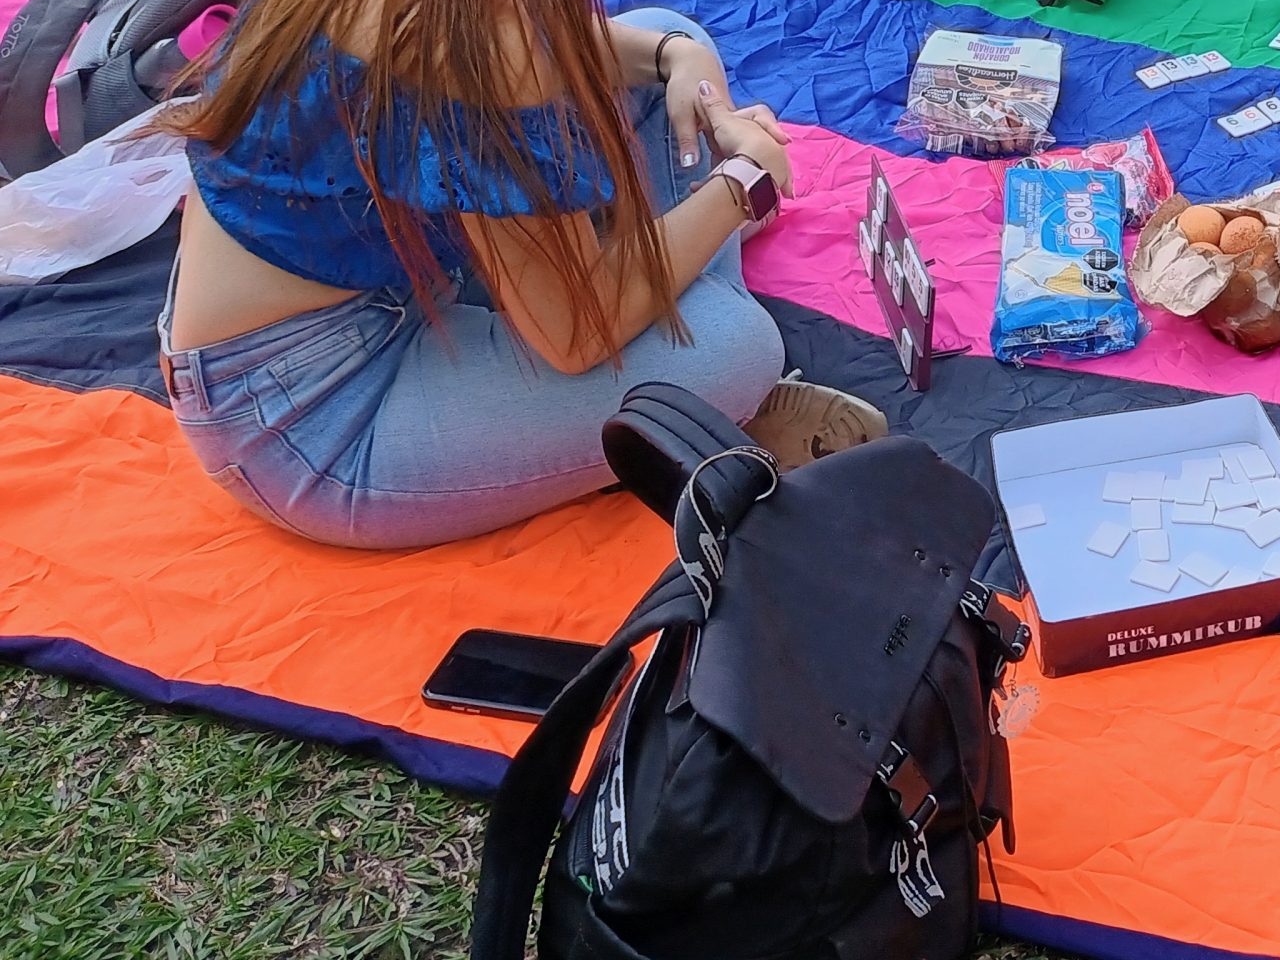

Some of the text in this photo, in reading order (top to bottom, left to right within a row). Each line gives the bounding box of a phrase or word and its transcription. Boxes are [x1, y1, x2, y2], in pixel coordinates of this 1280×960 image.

[1, 14, 30, 58] TOTTO
[1142, 52, 1220, 78] 13 13 13 13
[1226, 100, 1277, 126] 6 6 6
[1064, 192, 1105, 247] noel
[1107, 625, 1155, 642] DELUXE
[1108, 615, 1263, 658] RUMMIKUB
